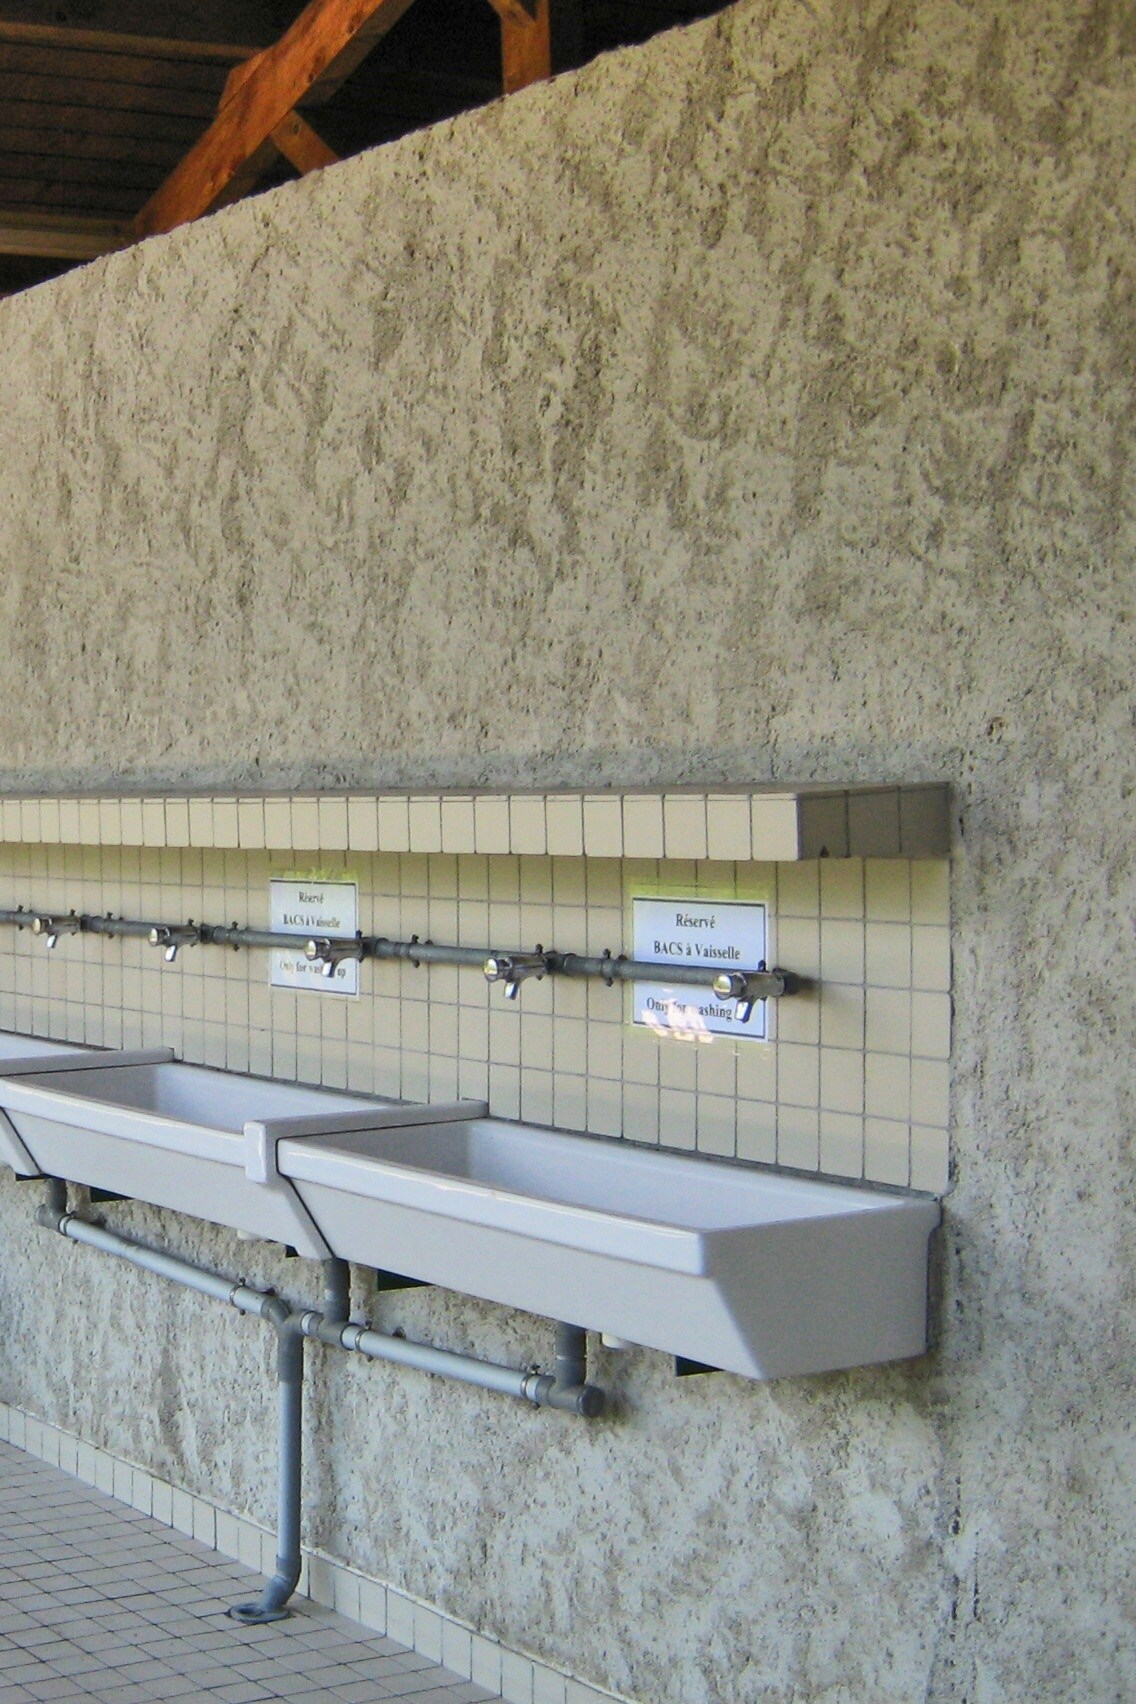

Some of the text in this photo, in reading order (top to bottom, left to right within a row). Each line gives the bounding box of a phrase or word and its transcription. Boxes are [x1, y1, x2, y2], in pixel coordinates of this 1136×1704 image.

[675, 913, 716, 929] Réservé
[654, 940, 741, 960] BACS à Vaisselle
[690, 1003, 733, 1022] ashing
